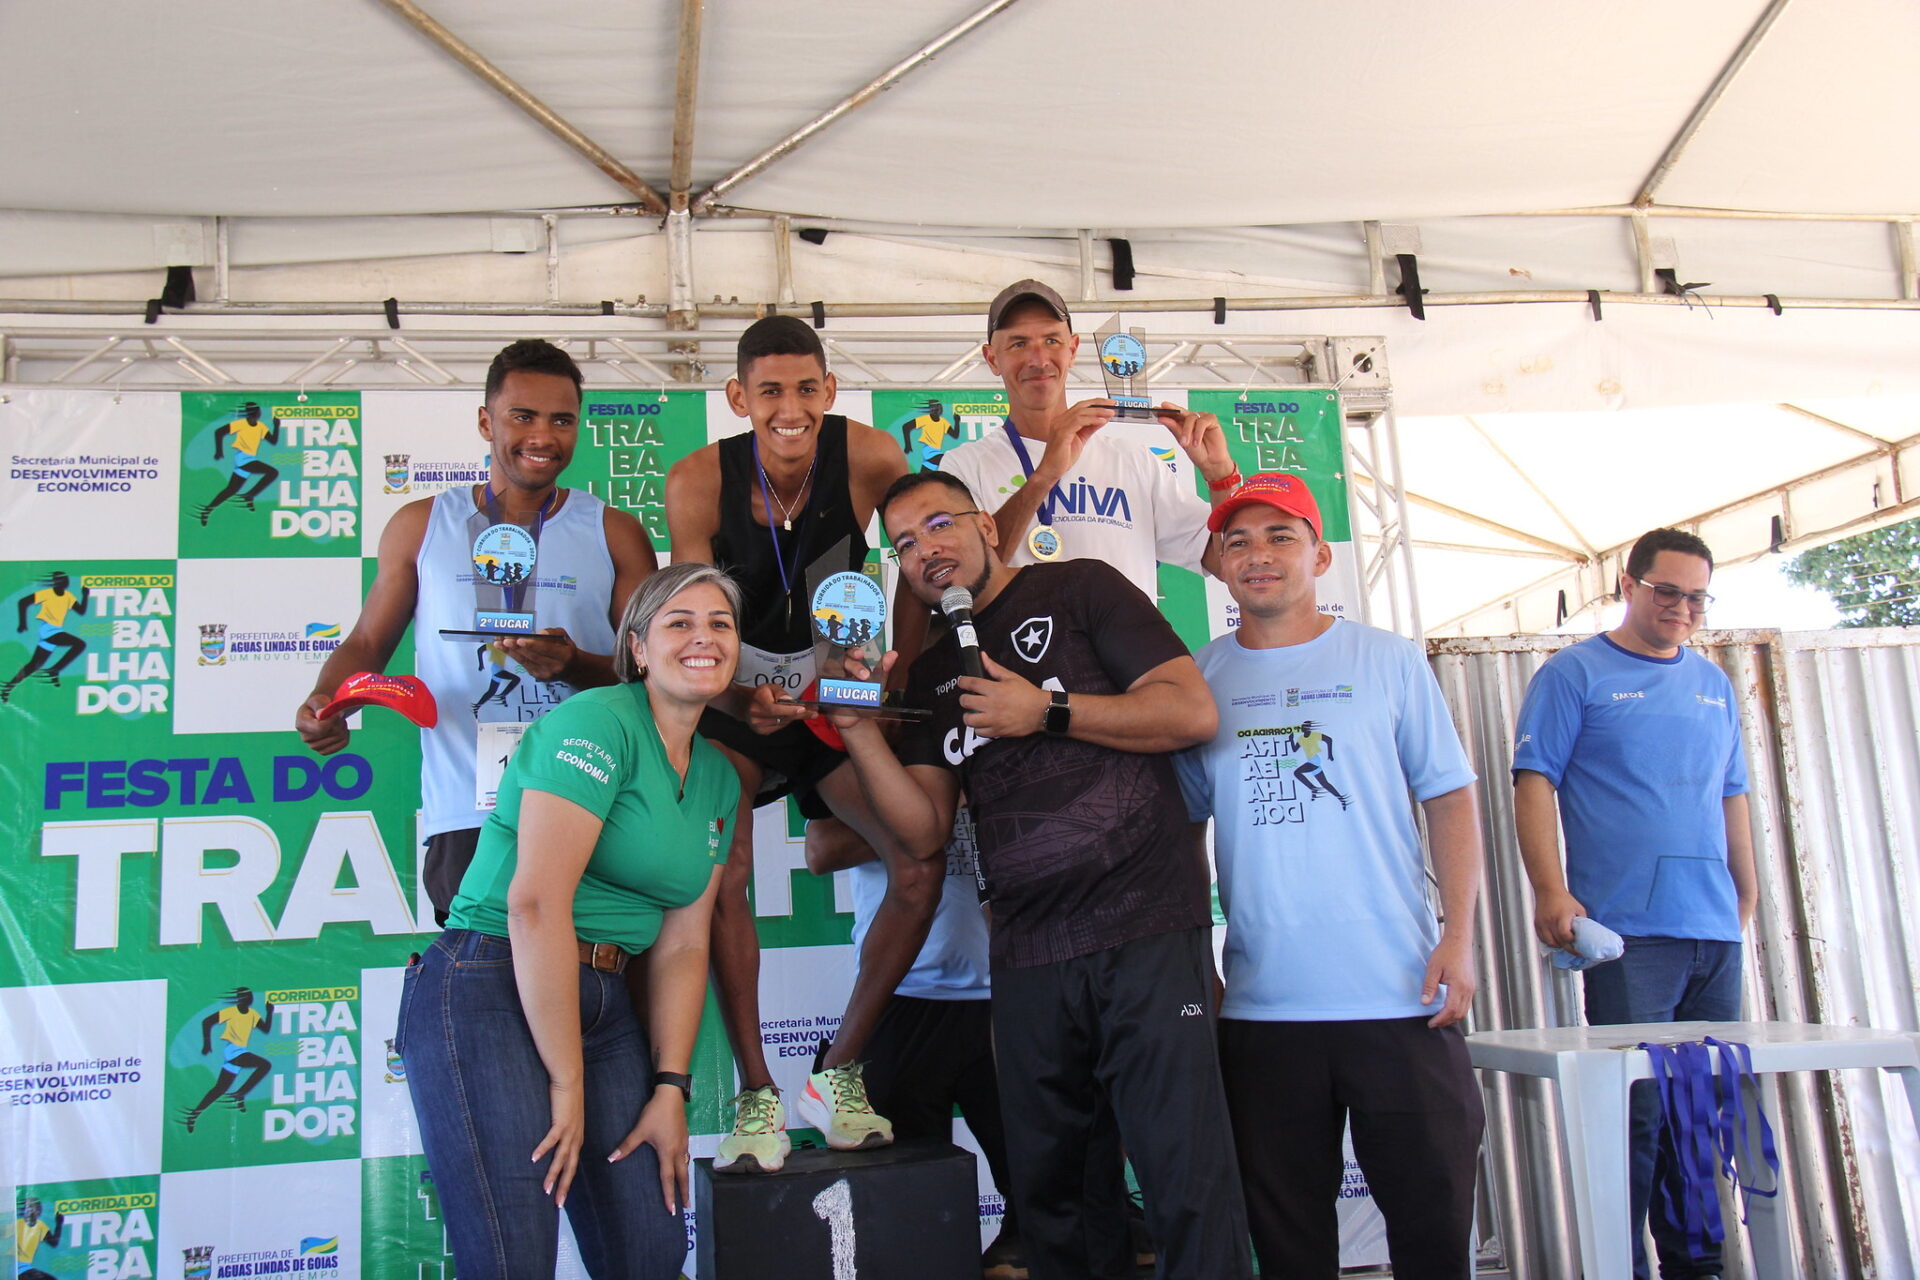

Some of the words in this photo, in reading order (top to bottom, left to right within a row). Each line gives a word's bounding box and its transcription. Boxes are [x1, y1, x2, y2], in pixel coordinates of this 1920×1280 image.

[275, 407, 333, 418] CORRIDA
[335, 406, 356, 417] DO
[588, 404, 635, 415] FESTA
[638, 404, 661, 415] DO
[955, 404, 1008, 414] CORRIDA
[1124, 400, 1149, 408] LUGAR
[1234, 402, 1276, 414] FESTA
[1279, 402, 1299, 414] DO
[279, 419, 358, 447] TRA
[586, 418, 665, 447] TRA
[1233, 416, 1305, 443] TRA
[12, 455, 75, 465] Secretaria
[80, 455, 139, 466] Municipal
[143, 456, 158, 465] de
[307, 449, 358, 477] BA
[610, 449, 665, 477] BA
[1257, 445, 1308, 470] BA
[11, 469, 158, 480] DESENVOLVIMENTO
[446, 471, 477, 481] LINDAS
[479, 471, 490, 481] DE
[37, 480, 131, 492] ECONÔMICO
[279, 480, 358, 507] LHA
[270, 510, 356, 538] DOR
[1053, 515, 1086, 523] ECNOLOGIA
[84, 577, 147, 588] CORRIDA
[149, 576, 171, 586] DO
[818, 582, 833, 606] CORRIDA
[842, 575, 880, 596] TRABALHADOR
[88, 588, 172, 617] TRA
[1331, 603, 1344, 612] de
[494, 618, 529, 629] LUGAR
[117, 620, 172, 649] BA
[230, 632, 286, 641] PREFEITURA
[288, 632, 300, 640] DE
[264, 641, 297, 652] LINDAS
[299, 641, 310, 651] DE
[230, 653, 248, 661] UM
[254, 653, 290, 661] NOVO
[296, 652, 331, 660] TEMP
[87, 652, 171, 682] LHA
[836, 688, 878, 701] LUGAR
[935, 676, 961, 697] Topp
[77, 685, 168, 715] DOR
[563, 738, 617, 771] SECRETARIA
[556, 750, 610, 784] ECONOMIA
[44, 758, 256, 810] FESTA
[273, 753, 374, 802] DO
[267, 988, 331, 1002] CORRIDA
[333, 987, 356, 999] DO
[273, 1001, 357, 1035] TRA
[761, 1017, 812, 1029] ecretaria
[815, 1015, 844, 1026] Muni
[301, 1035, 357, 1068] BA
[779, 1045, 818, 1057] ECON
[57, 1057, 121, 1071] Municipal
[125, 1056, 142, 1067] de
[272, 1069, 357, 1105] LHA
[11, 1088, 111, 1105] ECONÔMICO
[263, 1105, 355, 1141] DOR
[58, 1197, 129, 1212] CORRIDA
[131, 1195, 153, 1206] DO
[979, 1203, 1003, 1216] GUAS
[63, 1209, 154, 1248] TRA
[812, 1179, 858, 1280] 1
[91, 1246, 153, 1280] BA
[217, 1251, 279, 1264] PREFEITURA
[281, 1249, 294, 1258] DE
[254, 1260, 290, 1275] LINDAS
[293, 1258, 305, 1271] DE
